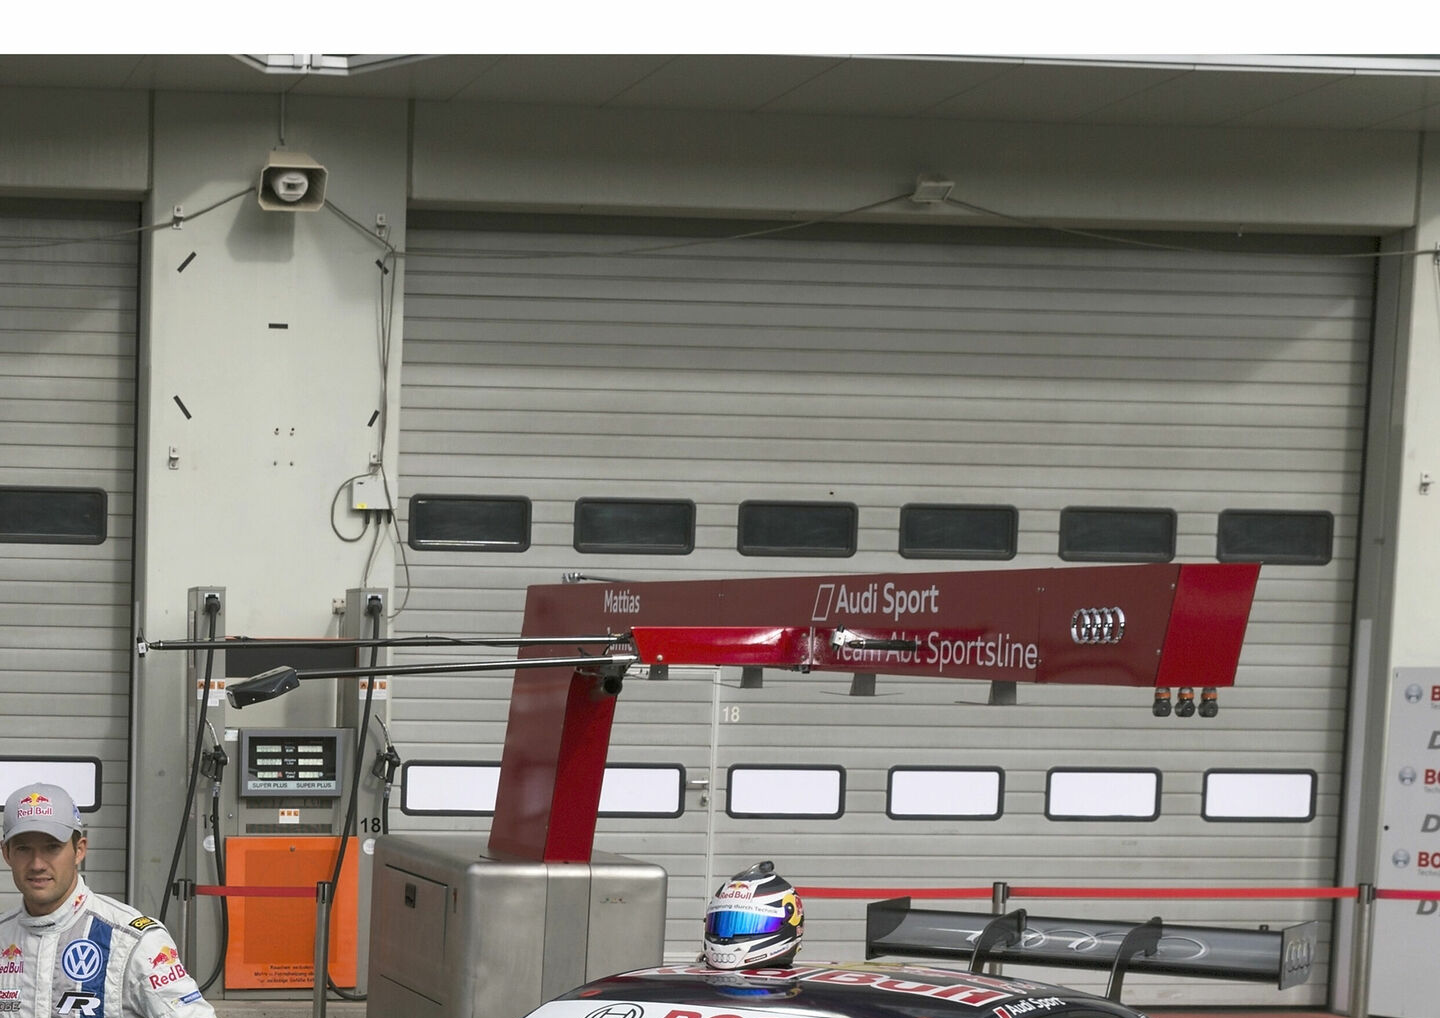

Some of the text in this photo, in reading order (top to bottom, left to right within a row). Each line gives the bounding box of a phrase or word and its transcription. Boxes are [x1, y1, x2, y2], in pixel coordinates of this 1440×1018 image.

[603, 589, 641, 614] Mattias
[835, 581, 940, 622] Audi Sport
[926, 630, 1039, 673] Sportsline
[723, 706, 740, 722] 18
[17, 806, 53, 818] Red Bull
[361, 817, 381, 833] 18
[734, 890, 752, 900] Bull
[9, 960, 24, 974] Bull
[149, 966, 177, 990] Red
[799, 967, 1017, 1007] Bull
[1004, 996, 1067, 1016] Audi Sport
